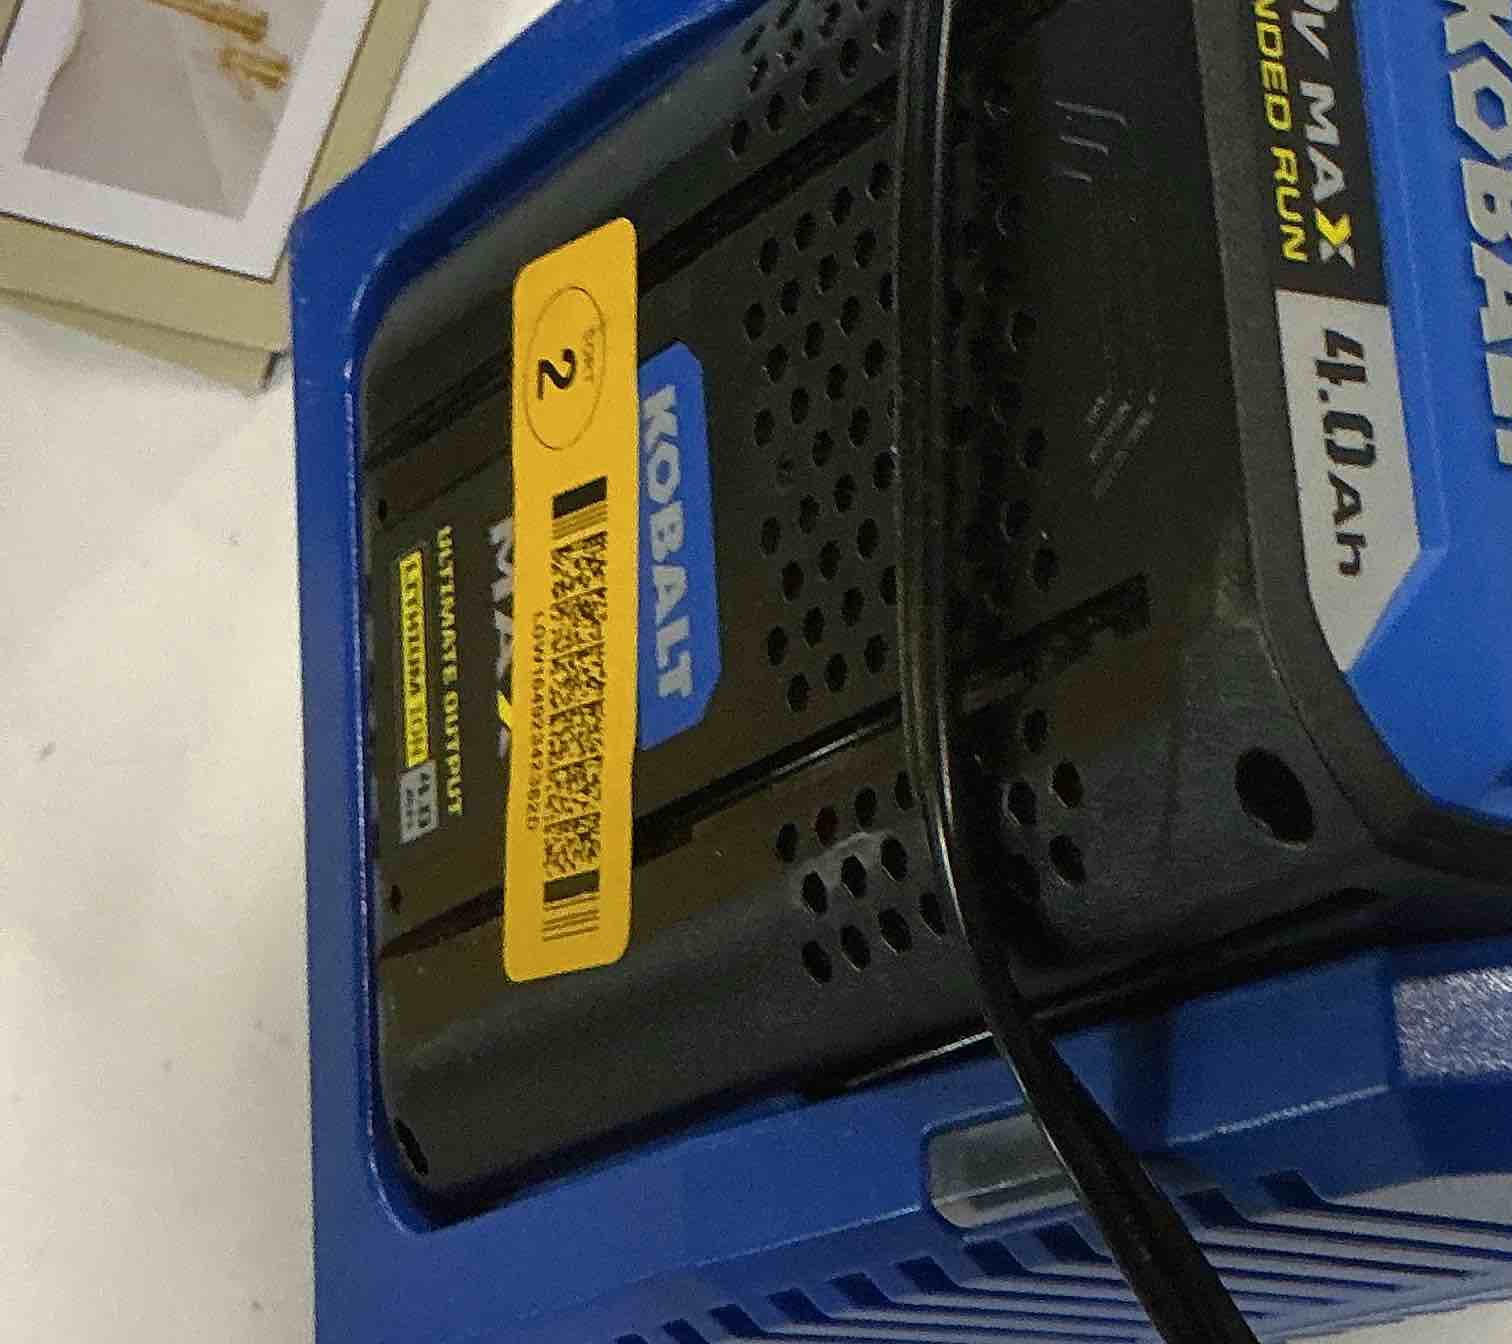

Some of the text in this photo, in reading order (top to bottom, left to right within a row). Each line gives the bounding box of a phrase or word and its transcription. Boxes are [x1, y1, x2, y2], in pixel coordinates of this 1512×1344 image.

[1271, 145, 1308, 264] RUN
[1301, 79, 1356, 270] MAX
[538, 347, 577, 401] 2
[641, 383, 693, 701] KOBALT
[437, 525, 465, 817] ULTIMATE OUTPUT
